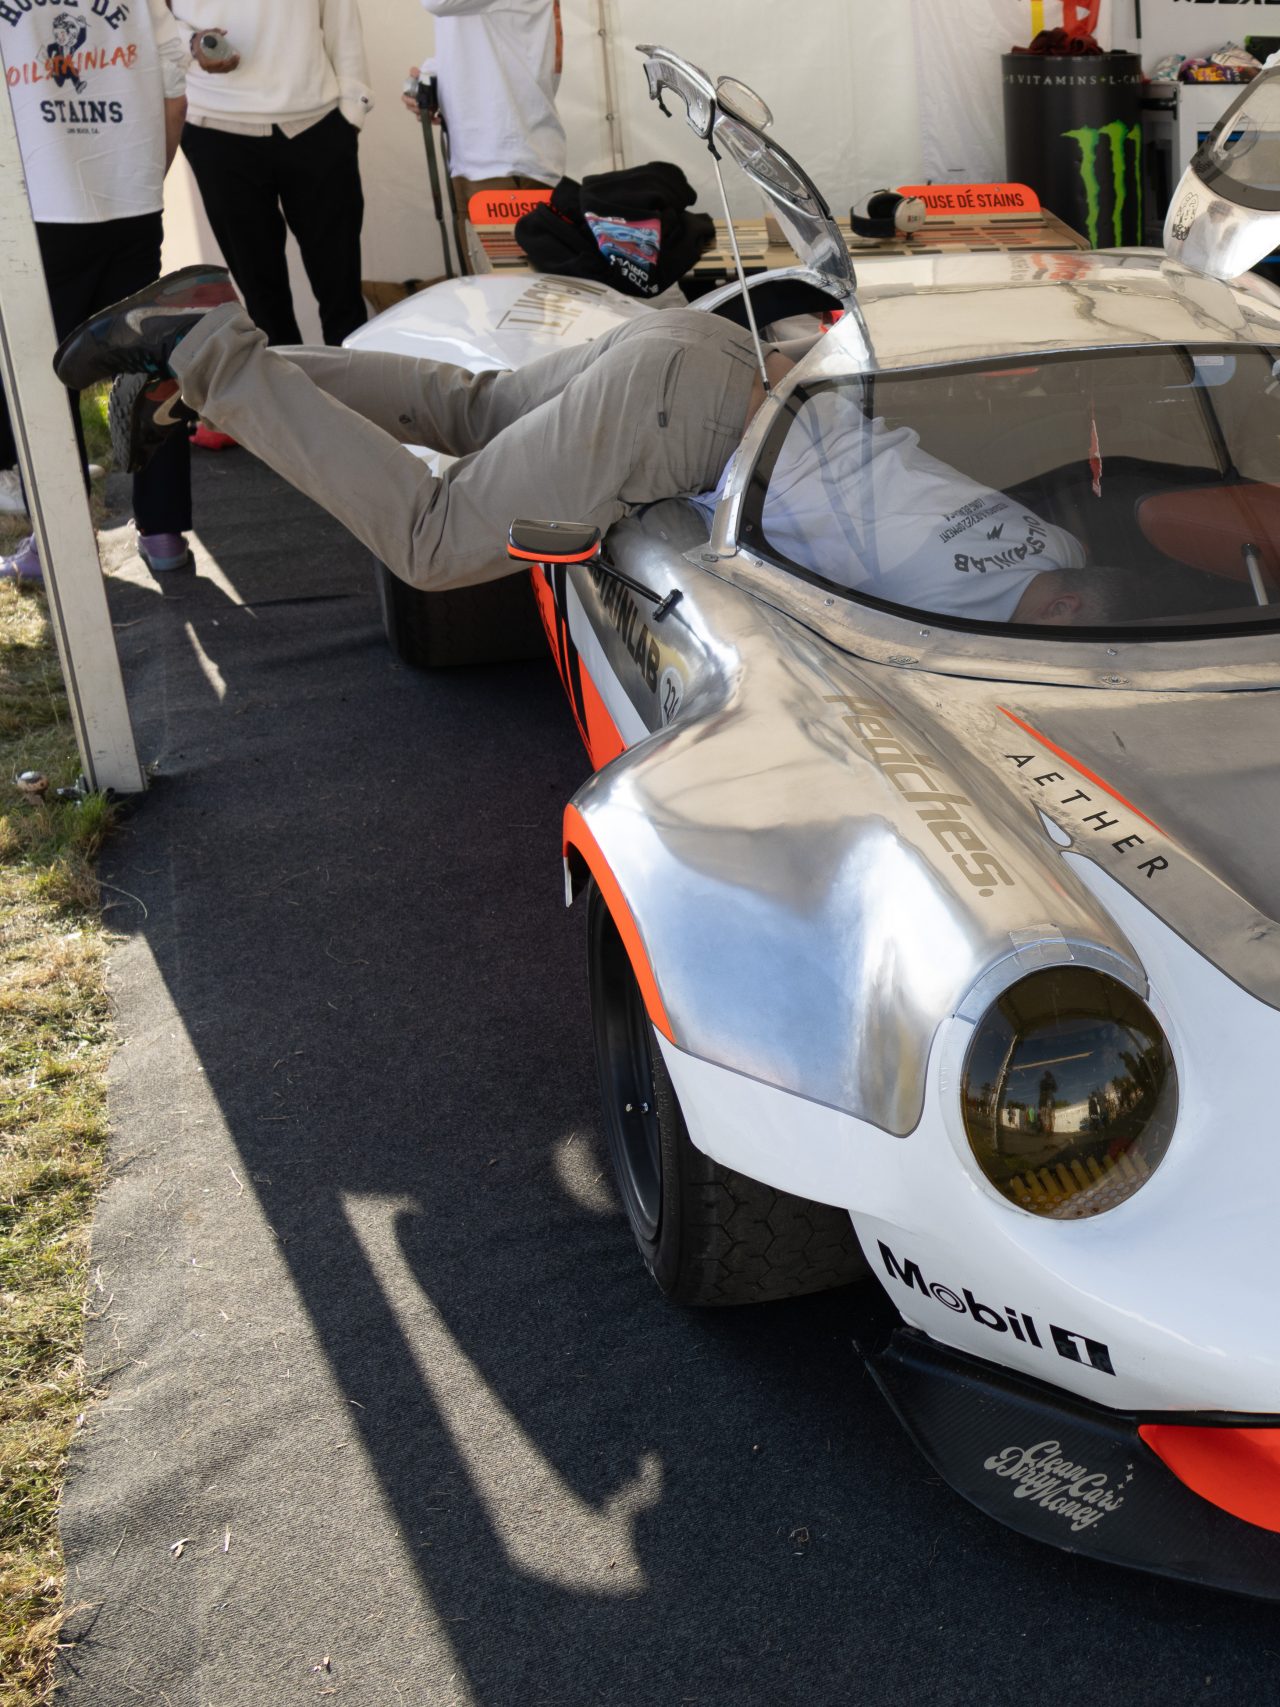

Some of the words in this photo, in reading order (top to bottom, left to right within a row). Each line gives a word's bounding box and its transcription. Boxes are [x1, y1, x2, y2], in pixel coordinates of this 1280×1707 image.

[1017, 74, 1097, 86] VITAMINS
[40, 100, 124, 123] STAINS
[958, 189, 976, 208] DÉ
[979, 193, 1025, 208] STAINS
[953, 514, 1047, 574] OILSTAINLAB
[1005, 752, 1169, 879] AETHER
[877, 1238, 1043, 1349] Mobil
[983, 1446, 1062, 1498] Dirty
[1022, 1440, 1088, 1482] Clean
[1068, 1473, 1124, 1511] Cars
